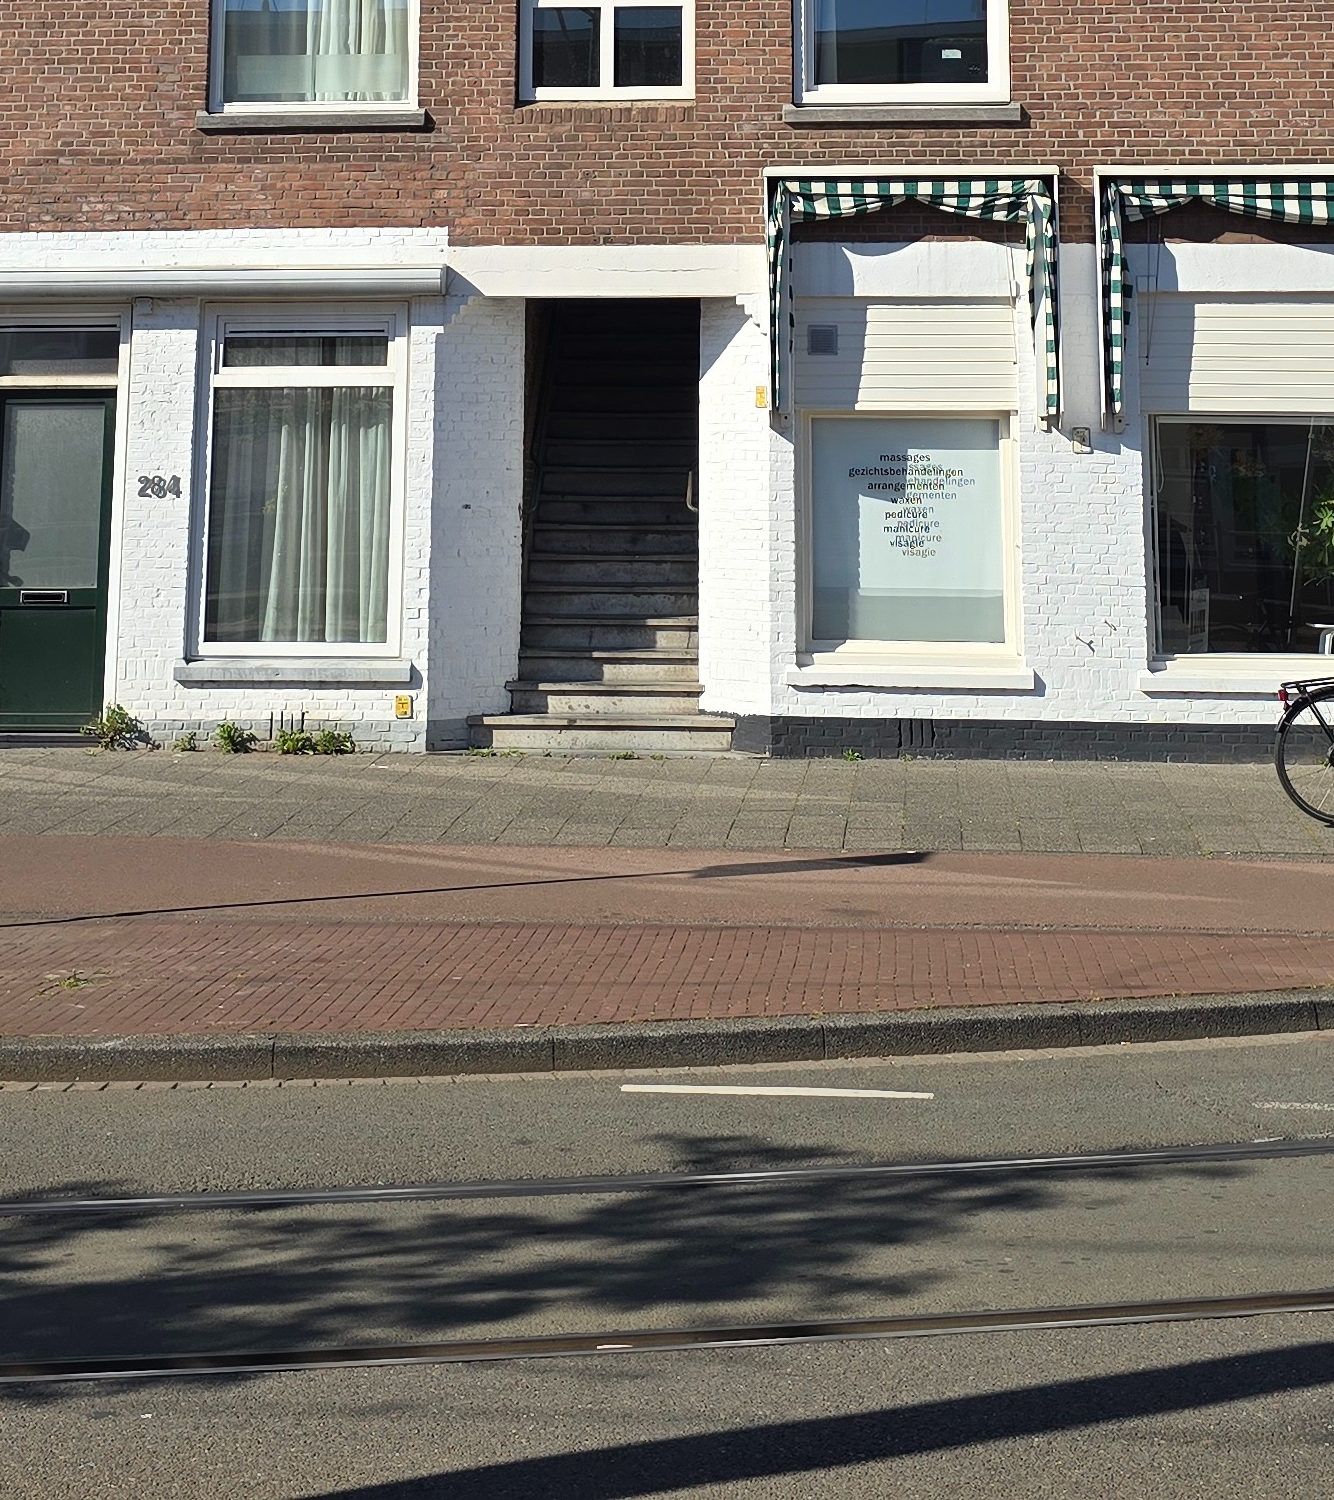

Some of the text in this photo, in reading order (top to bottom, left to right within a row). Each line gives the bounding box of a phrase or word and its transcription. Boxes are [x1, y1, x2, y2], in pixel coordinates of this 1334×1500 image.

[879, 453, 931, 464] massages
[848, 466, 964, 479] gezichtsbehandelingen
[137, 474, 183, 499] 284
[867, 481, 945, 492] arrangementen
[890, 496, 923, 505] waxen
[884, 510, 928, 521] pedicure
[883, 525, 931, 533] manicure
[889, 539, 925, 550] visagie
